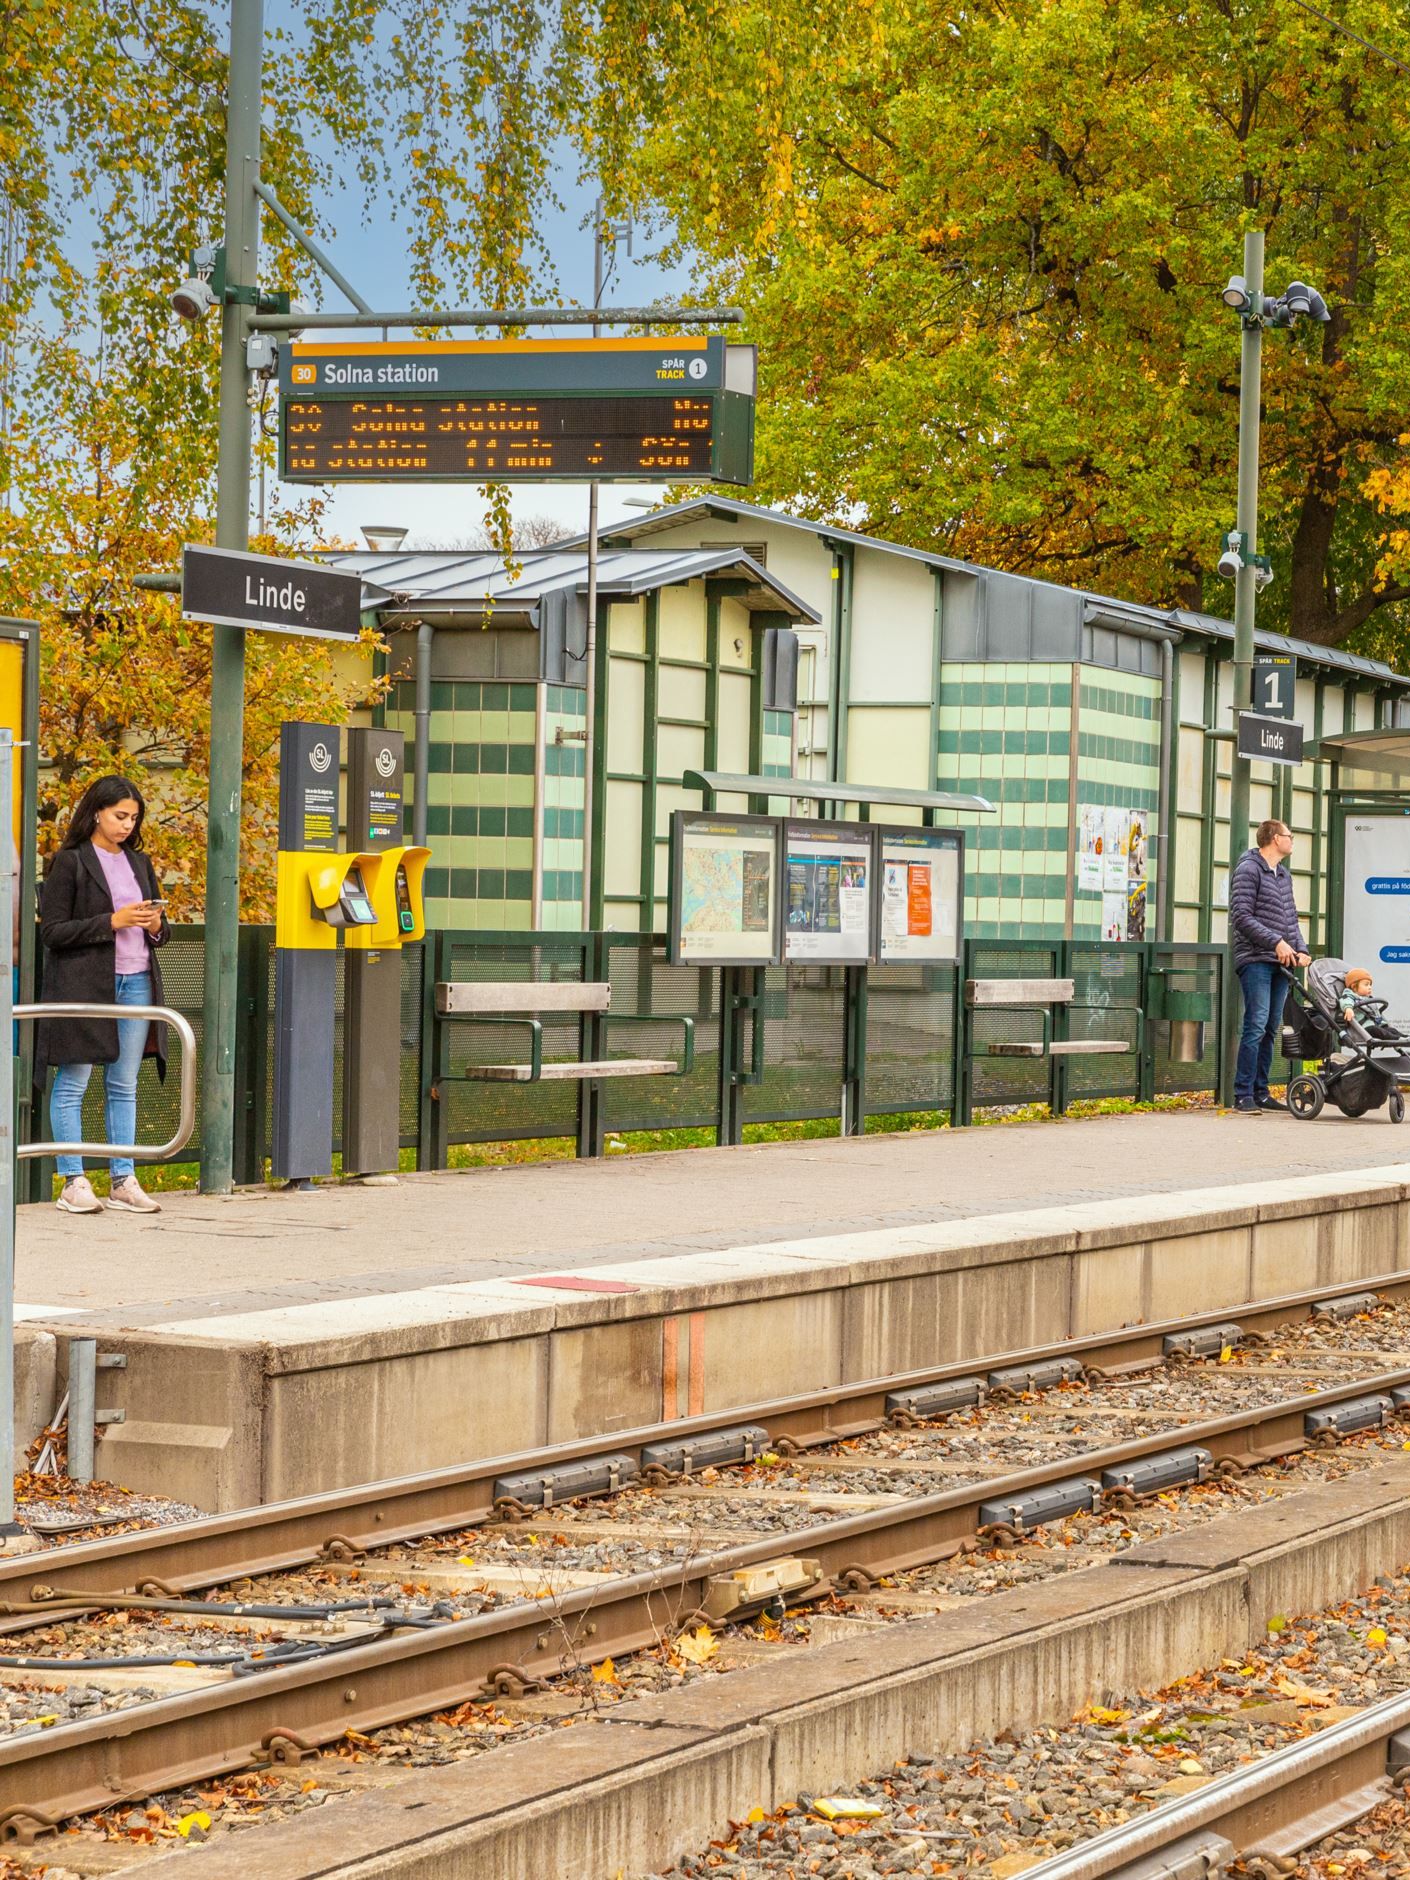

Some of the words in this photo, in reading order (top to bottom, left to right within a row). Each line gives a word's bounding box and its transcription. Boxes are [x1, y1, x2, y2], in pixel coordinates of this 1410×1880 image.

[662, 357, 685, 368] SPÅR
[297, 368, 311, 381] 30
[324, 364, 374, 384] Solna
[377, 363, 439, 384] station
[694, 363, 702, 375] 1
[656, 370, 685, 380] TRACK
[245, 575, 306, 612] Linde
[1265, 671, 1283, 708] 1
[1261, 729, 1284, 750] Linde
[316, 749, 324, 759] SL
[382, 754, 390, 764] SL
[1371, 882, 1391, 890] grattis
[1392, 881, 1400, 890] på
[1386, 951, 1397, 959] Jag
